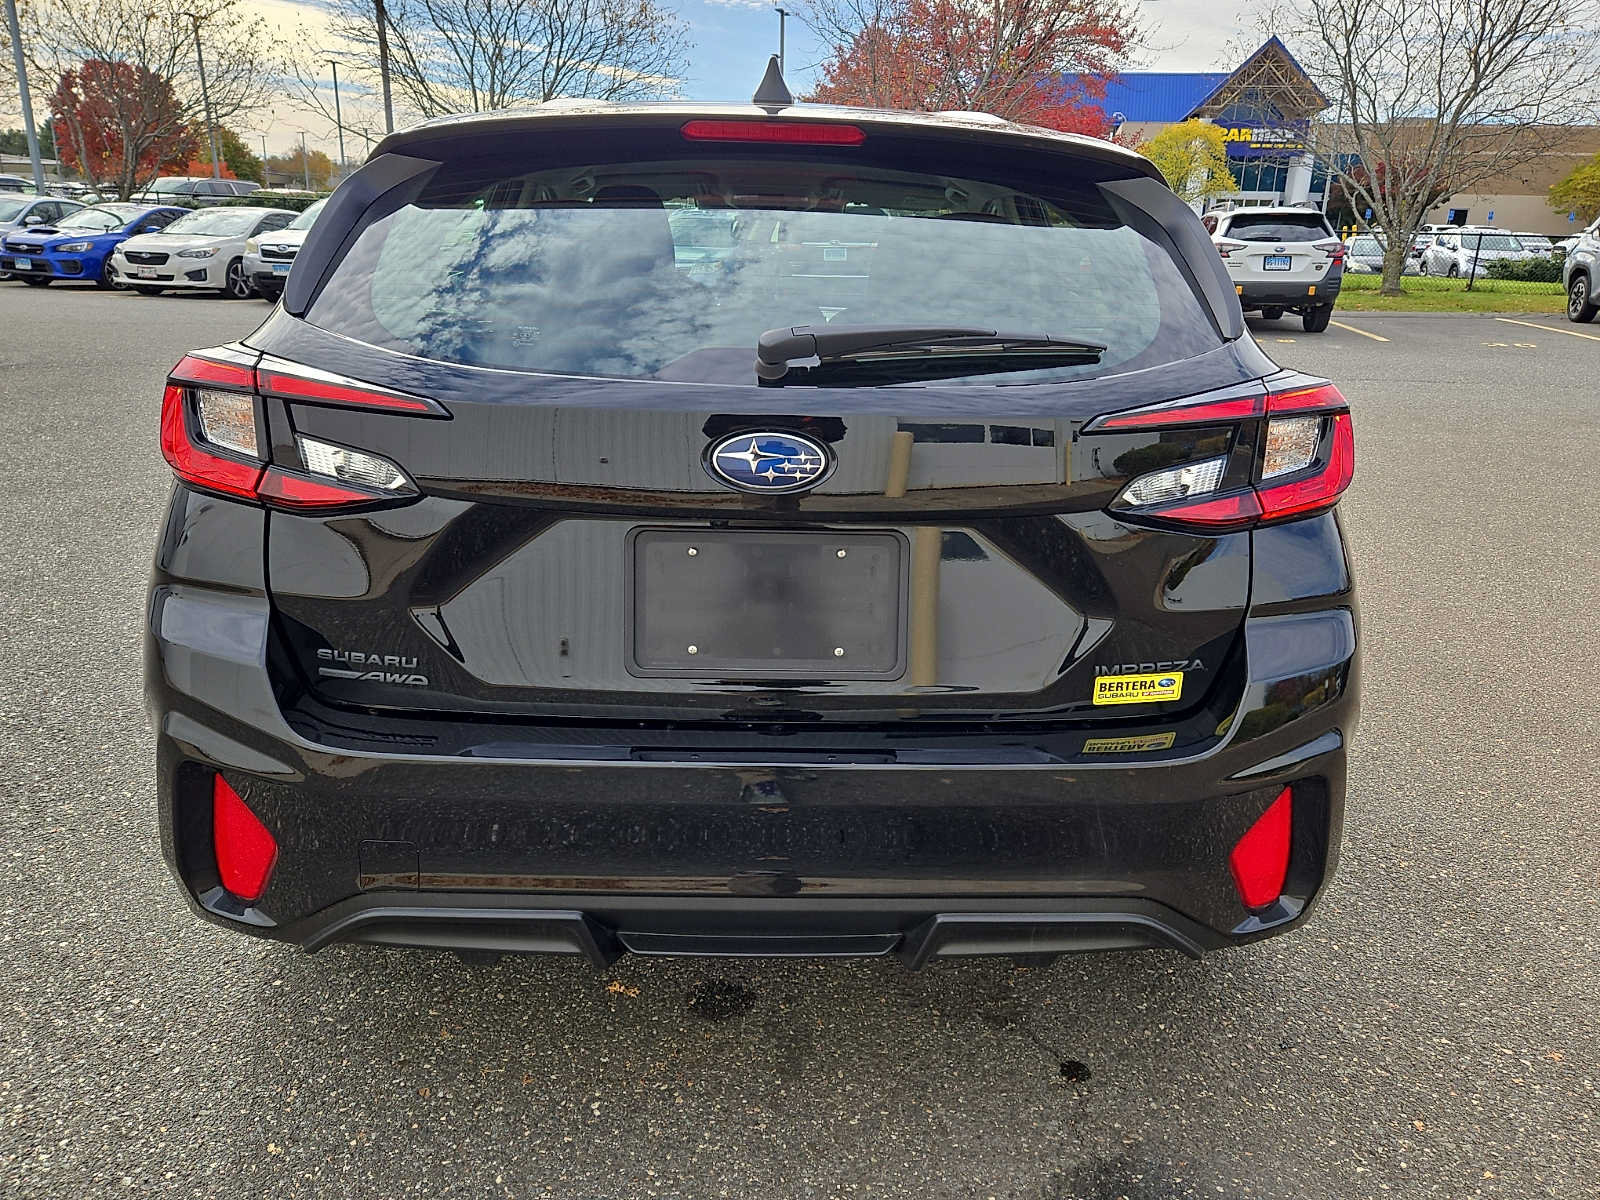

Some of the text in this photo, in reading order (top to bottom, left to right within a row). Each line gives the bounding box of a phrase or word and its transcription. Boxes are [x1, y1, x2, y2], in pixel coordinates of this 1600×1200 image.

[316, 648, 418, 668] SUBARU
[1095, 659, 1205, 676] IMPREZA
[361, 671, 429, 685] AWD
[1099, 680, 1156, 692] BERTERA
